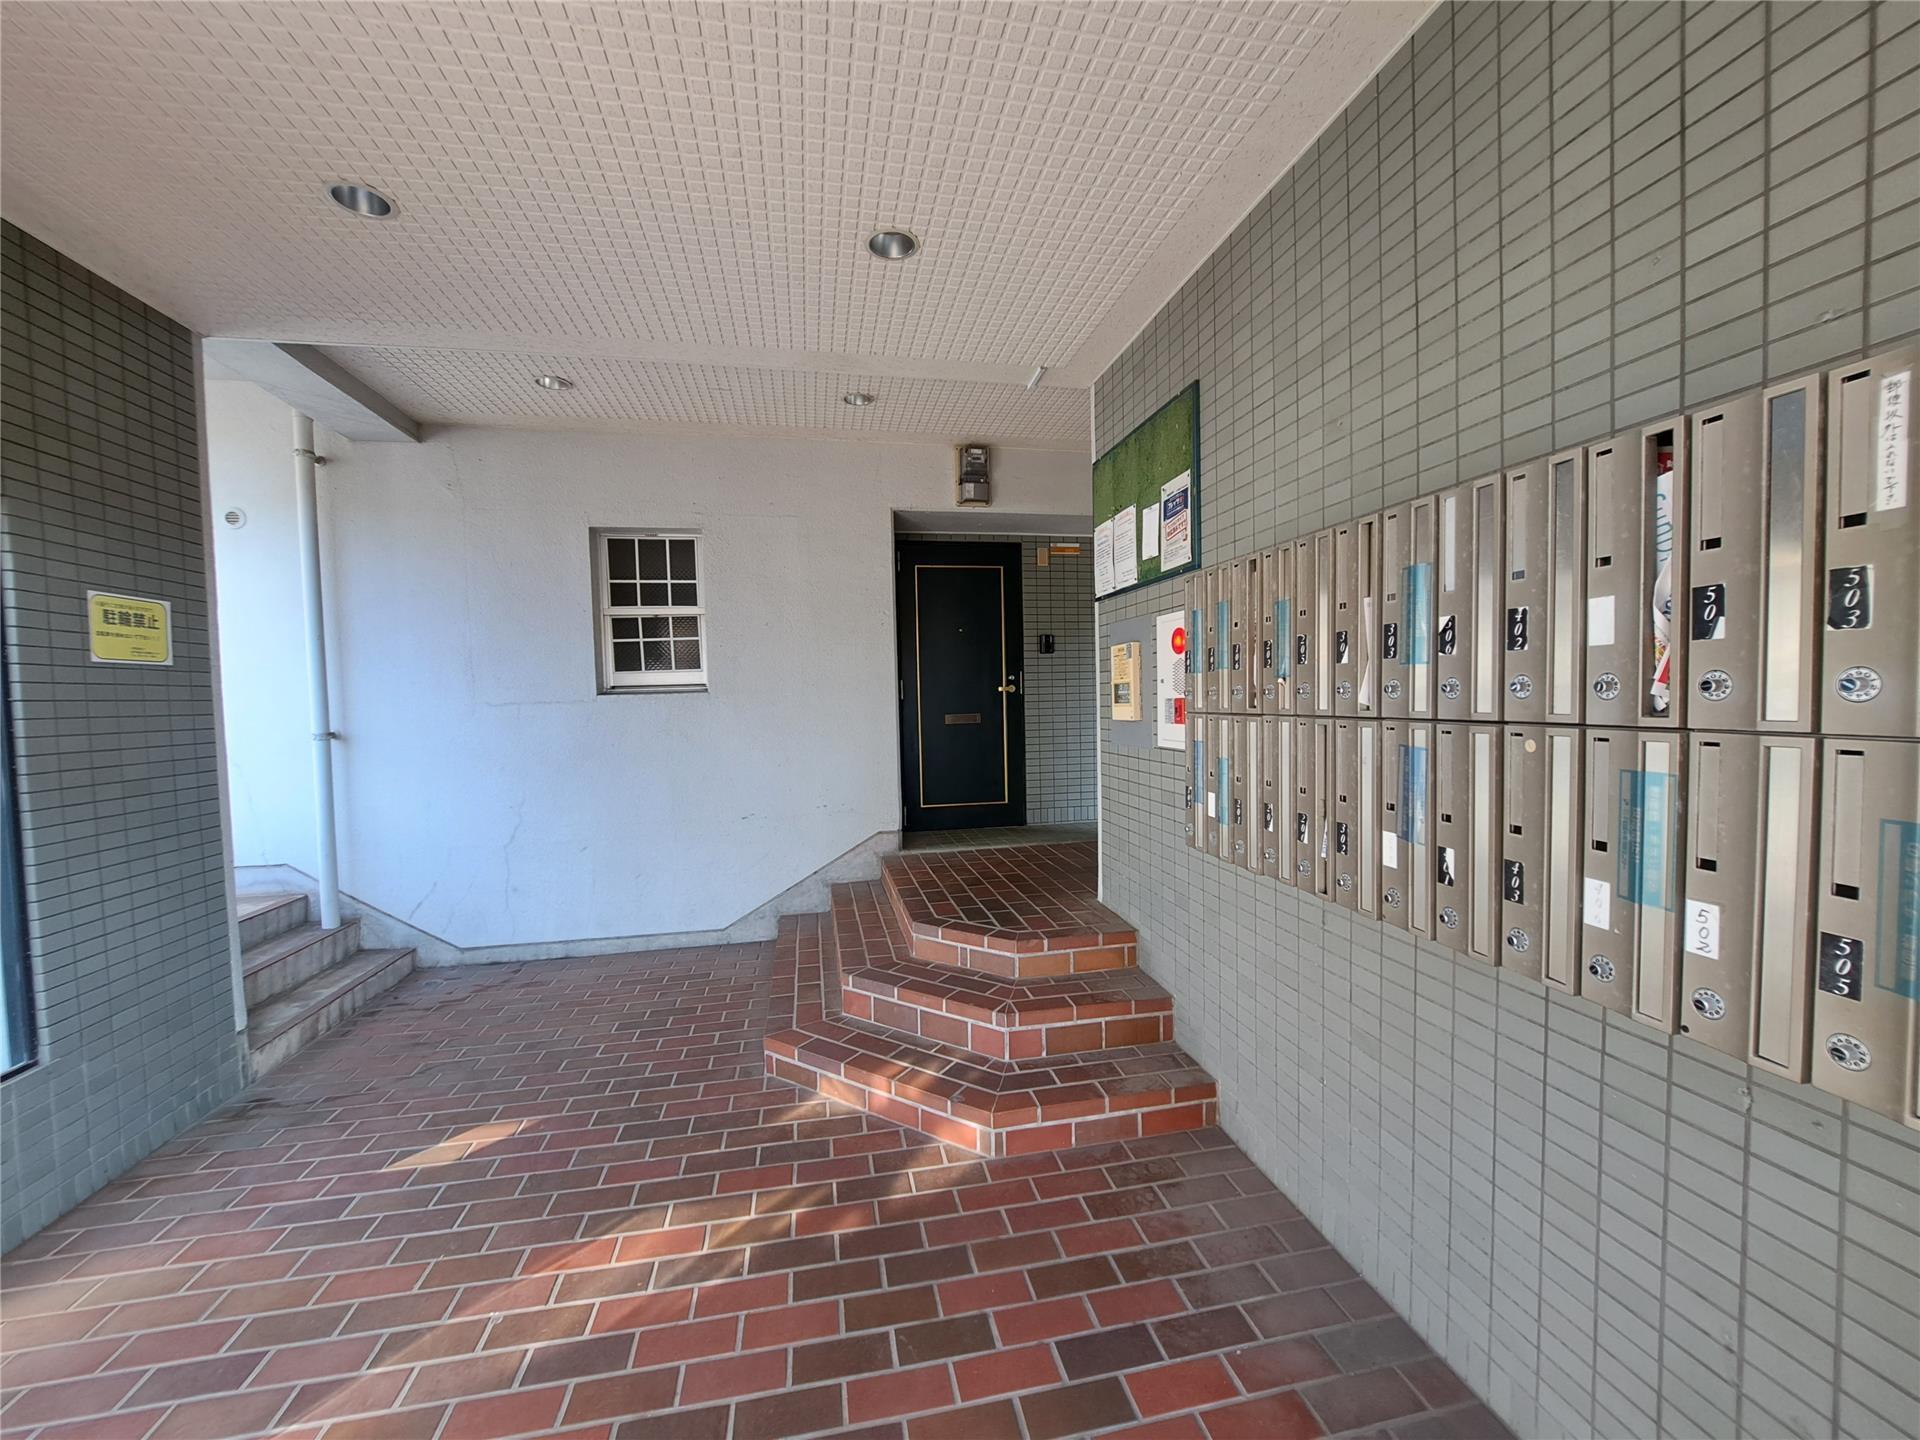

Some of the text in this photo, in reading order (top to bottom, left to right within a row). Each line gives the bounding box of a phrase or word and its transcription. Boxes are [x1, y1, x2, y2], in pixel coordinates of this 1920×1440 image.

[103, 607, 160, 630] 駐輪禁止
[1841, 568, 1861, 629] 503
[1387, 623, 1395, 659] 303
[1513, 608, 1523, 650] 402
[1510, 862, 1520, 902] 403
[1695, 908, 1712, 954] 502
[1833, 937, 1852, 996] 505
